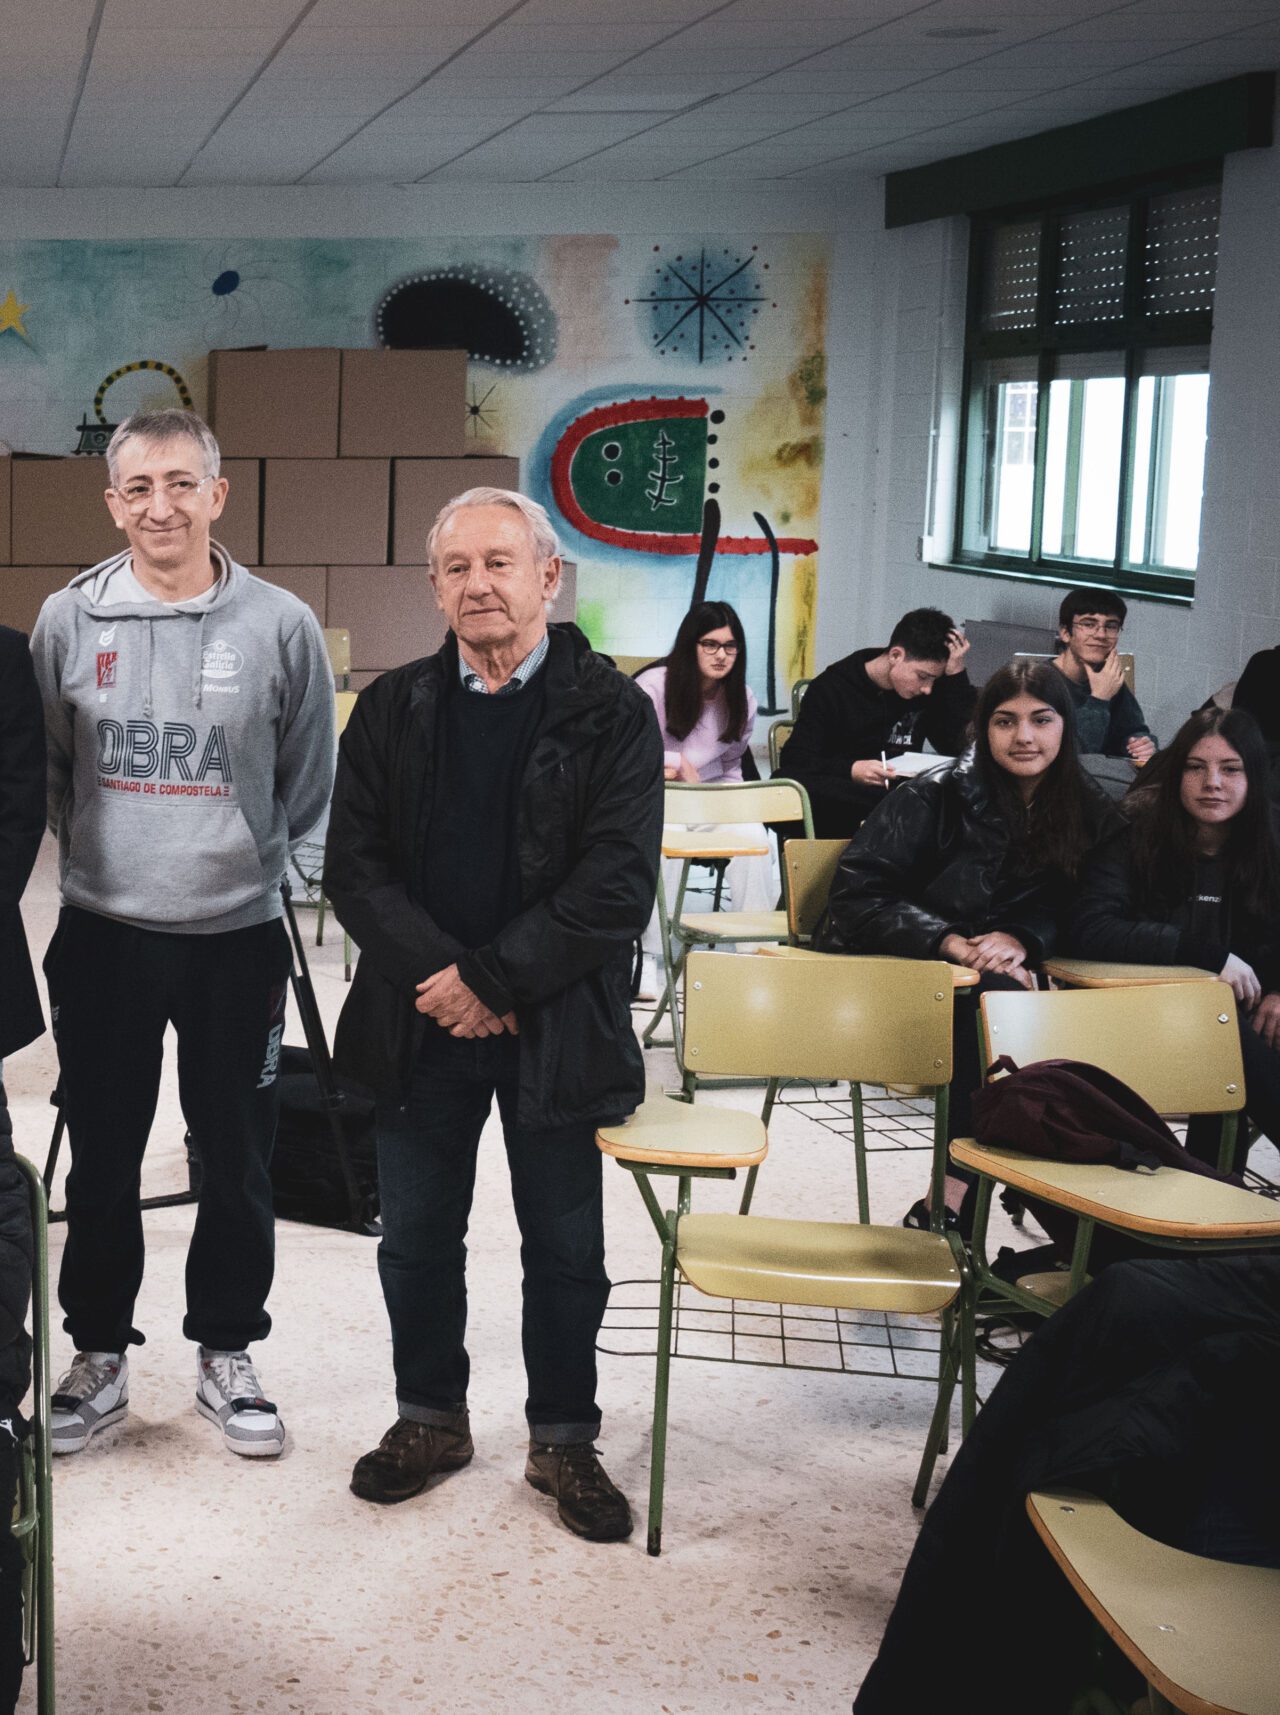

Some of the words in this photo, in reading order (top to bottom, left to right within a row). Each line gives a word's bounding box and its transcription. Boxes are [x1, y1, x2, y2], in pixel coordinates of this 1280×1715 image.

[96, 719, 233, 783] OBRA
[101, 777, 141, 793] SANTIAGO
[143, 782, 156, 795] DE
[159, 784, 222, 797] COMPOSTELA
